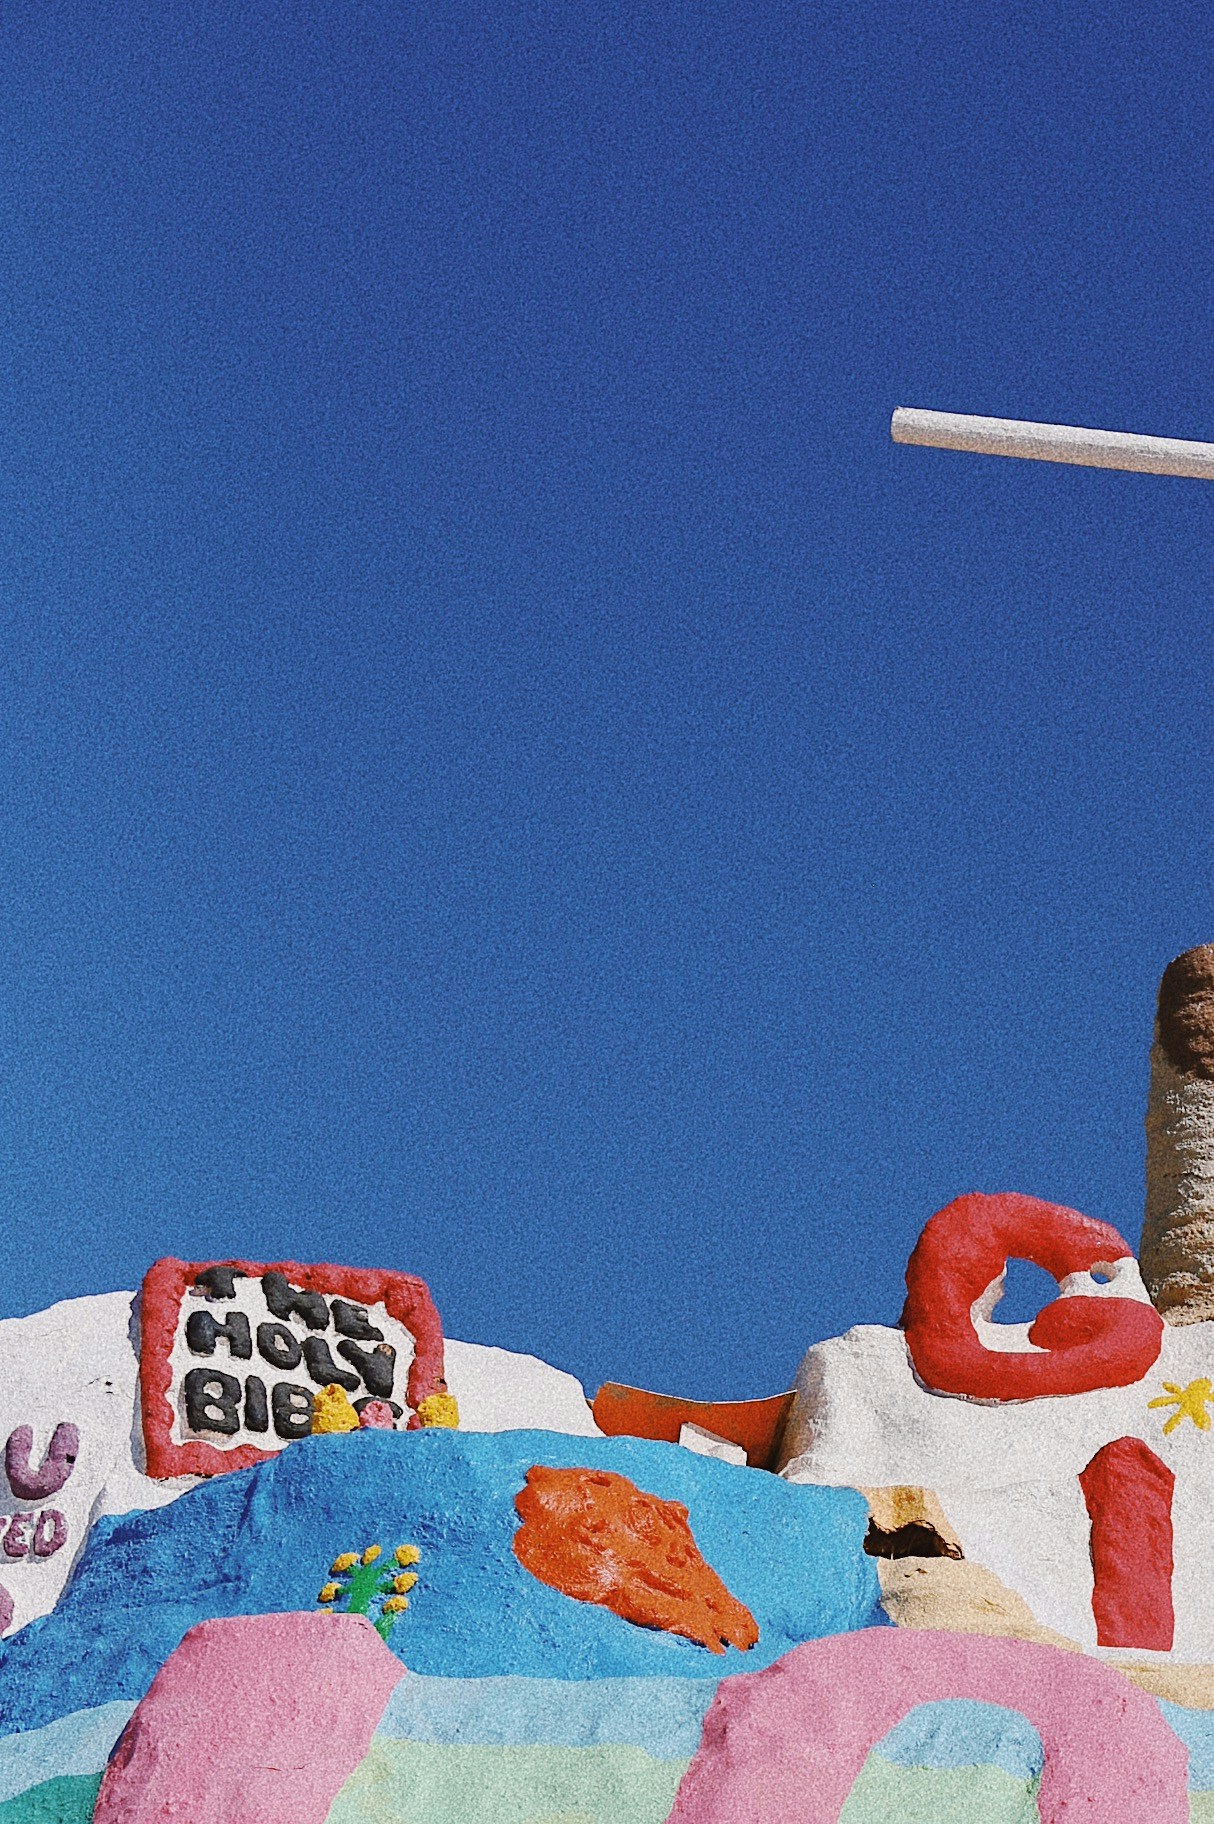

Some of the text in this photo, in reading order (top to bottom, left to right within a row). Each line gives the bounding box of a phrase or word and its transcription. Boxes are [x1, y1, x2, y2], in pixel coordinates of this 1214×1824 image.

[195, 1266, 385, 1342] THE
[186, 1310, 396, 1398] HOLY
[185, 1368, 403, 1440] BIB
